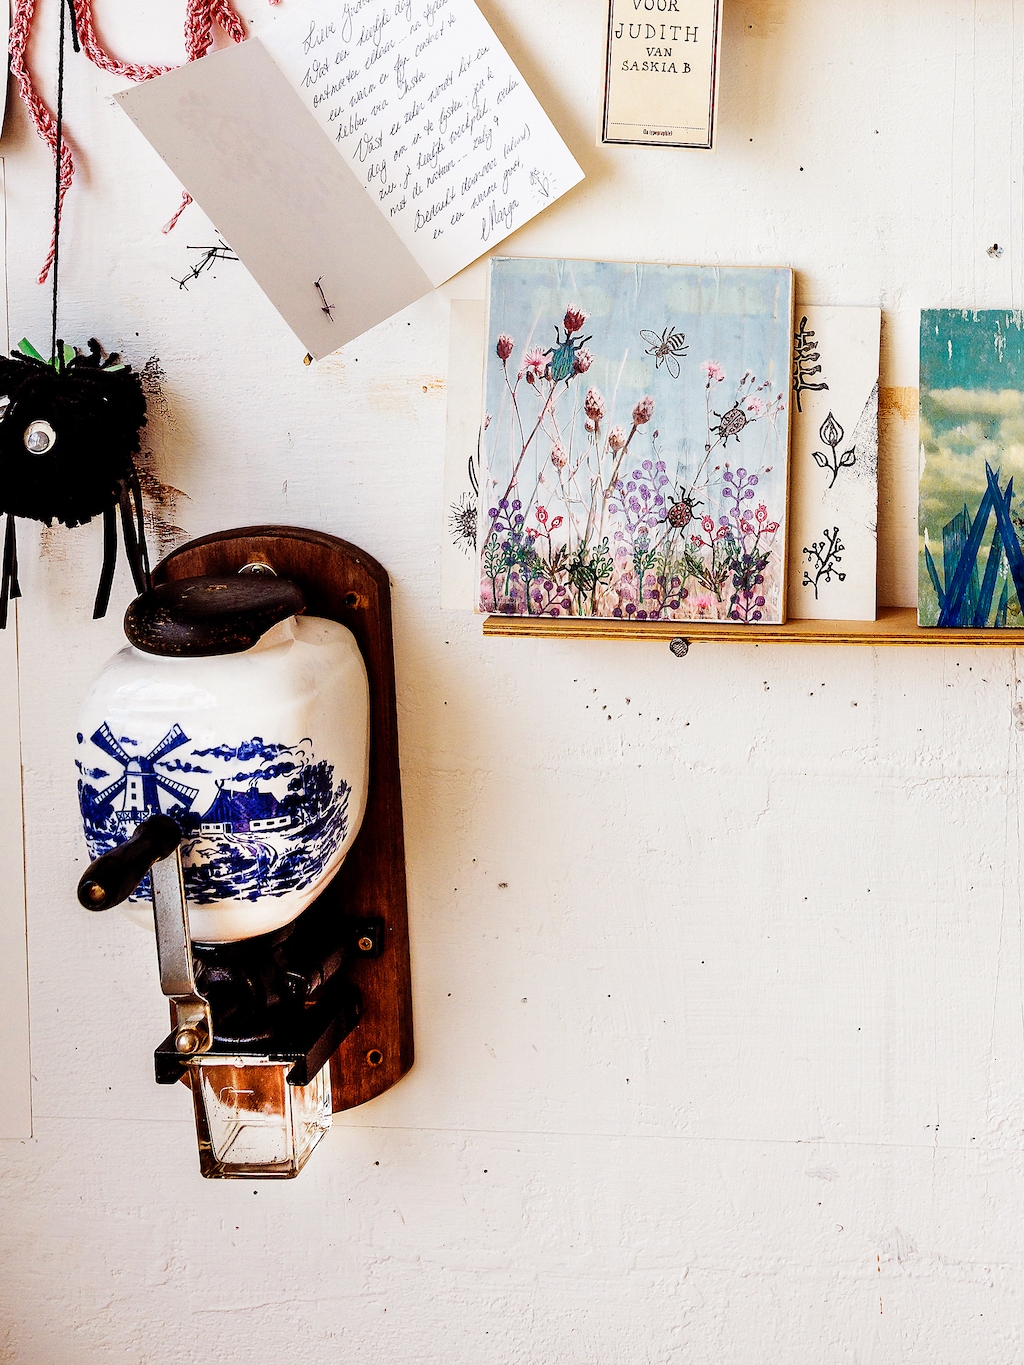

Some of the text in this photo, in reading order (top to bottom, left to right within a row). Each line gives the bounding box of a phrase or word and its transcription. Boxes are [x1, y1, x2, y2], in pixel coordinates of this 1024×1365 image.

[614, 23, 699, 43] JUDITH
[646, 47, 672, 57] VAN
[622, 60, 692, 74] SASKIA B
